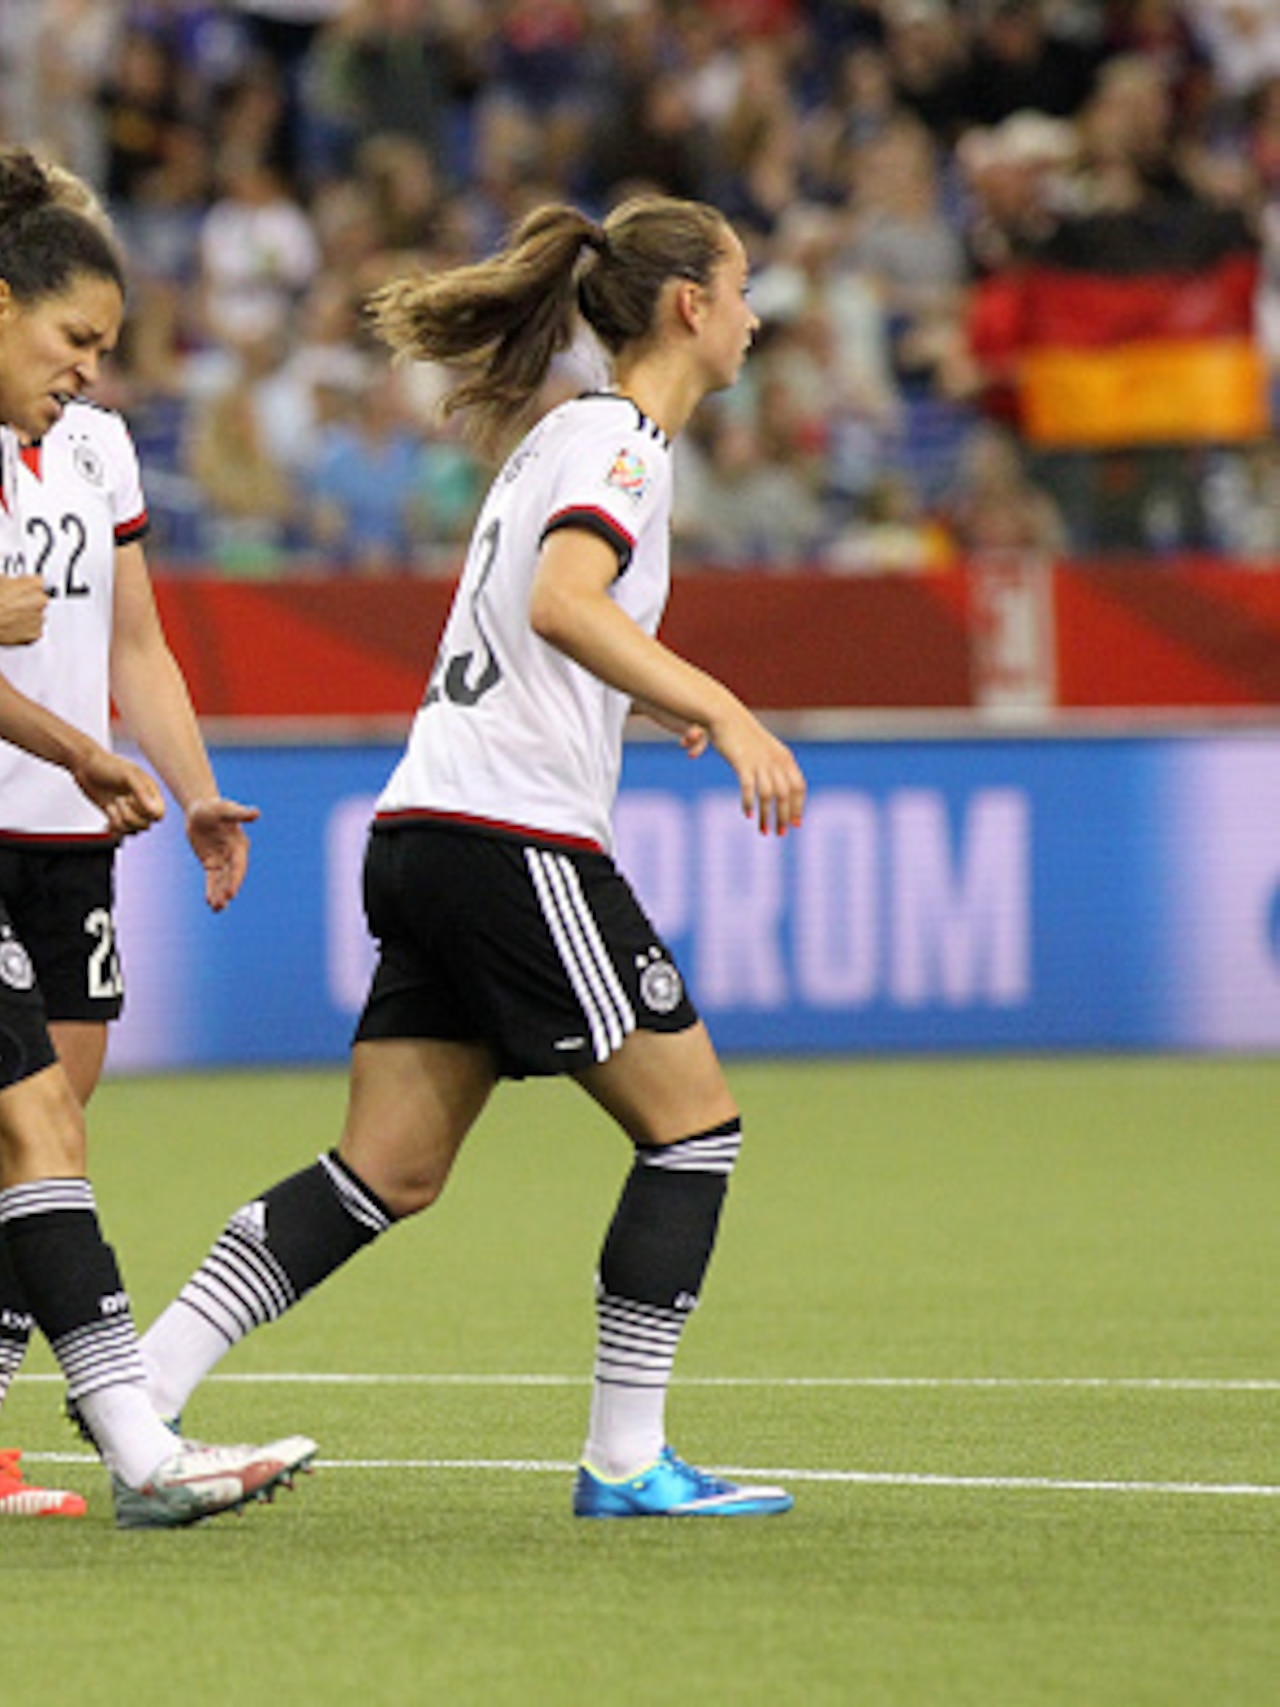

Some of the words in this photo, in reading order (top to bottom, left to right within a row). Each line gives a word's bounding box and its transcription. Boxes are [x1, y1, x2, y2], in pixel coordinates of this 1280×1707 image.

[26, 513, 91, 599] 22
[422, 517, 502, 706] 3
[84, 907, 124, 999] 2
